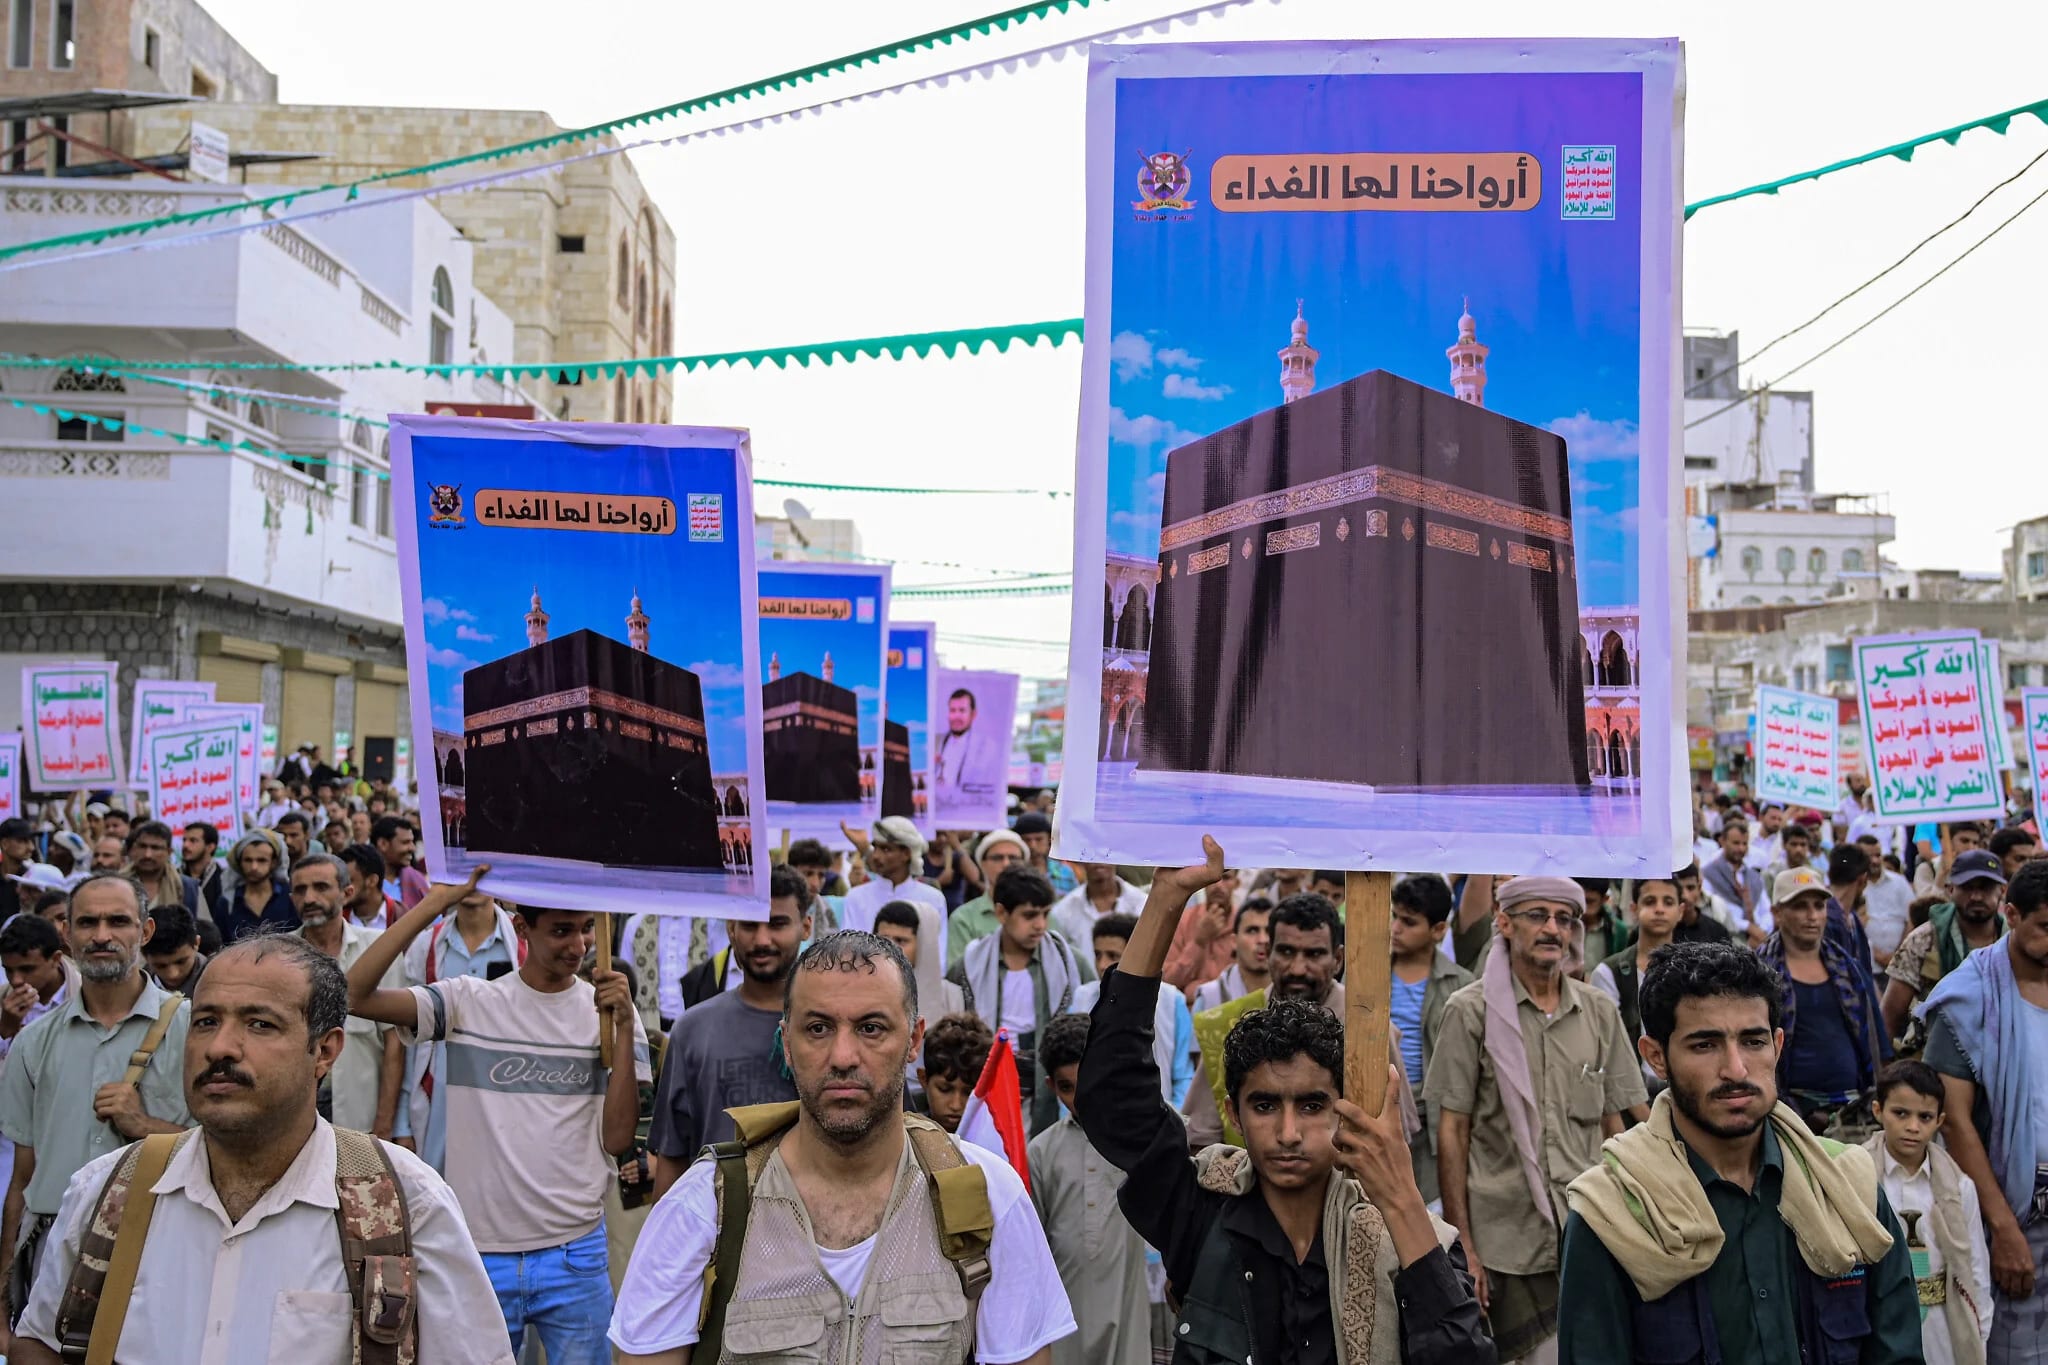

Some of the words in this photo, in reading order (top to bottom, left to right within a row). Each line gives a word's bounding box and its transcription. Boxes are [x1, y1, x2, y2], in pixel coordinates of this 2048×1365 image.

[1566, 148, 1593, 165] أكبر
[1595, 151, 1611, 162] الله
[1592, 166, 1611, 176] الموت
[1225, 164, 1329, 201] الفداء
[1343, 164, 1398, 200] لها
[1411, 156, 1528, 208] أرواحنا
[1592, 180, 1611, 188] الموت
[1566, 192, 1582, 200] اليهود
[1584, 192, 1593, 200] على
[1565, 202, 1588, 215] للإسلام
[1591, 201, 1610, 214] النصر
[484, 498, 548, 521] الفداء
[555, 500, 590, 523] لها
[597, 500, 667, 532] أرواحنا
[788, 602, 806, 614] لها
[1869, 644, 1929, 688] أكبر
[1935, 648, 1972, 674] الله
[1932, 685, 1976, 708] الموت
[1768, 701, 1802, 717] أكبر
[1808, 709, 1830, 722] الله
[1936, 714, 1980, 738] الموت
[161, 734, 204, 770] أكبر
[206, 736, 232, 757] الله
[1950, 744, 1984, 762] اللعنة
[1879, 749, 1918, 772] اليهود
[1923, 747, 1944, 768] على
[201, 766, 232, 786] الموت
[1944, 768, 1990, 803] النصر
[202, 790, 232, 811] الموت
[1884, 776, 1936, 807] للإسلام
[490, 1057, 590, 1084] Circles
